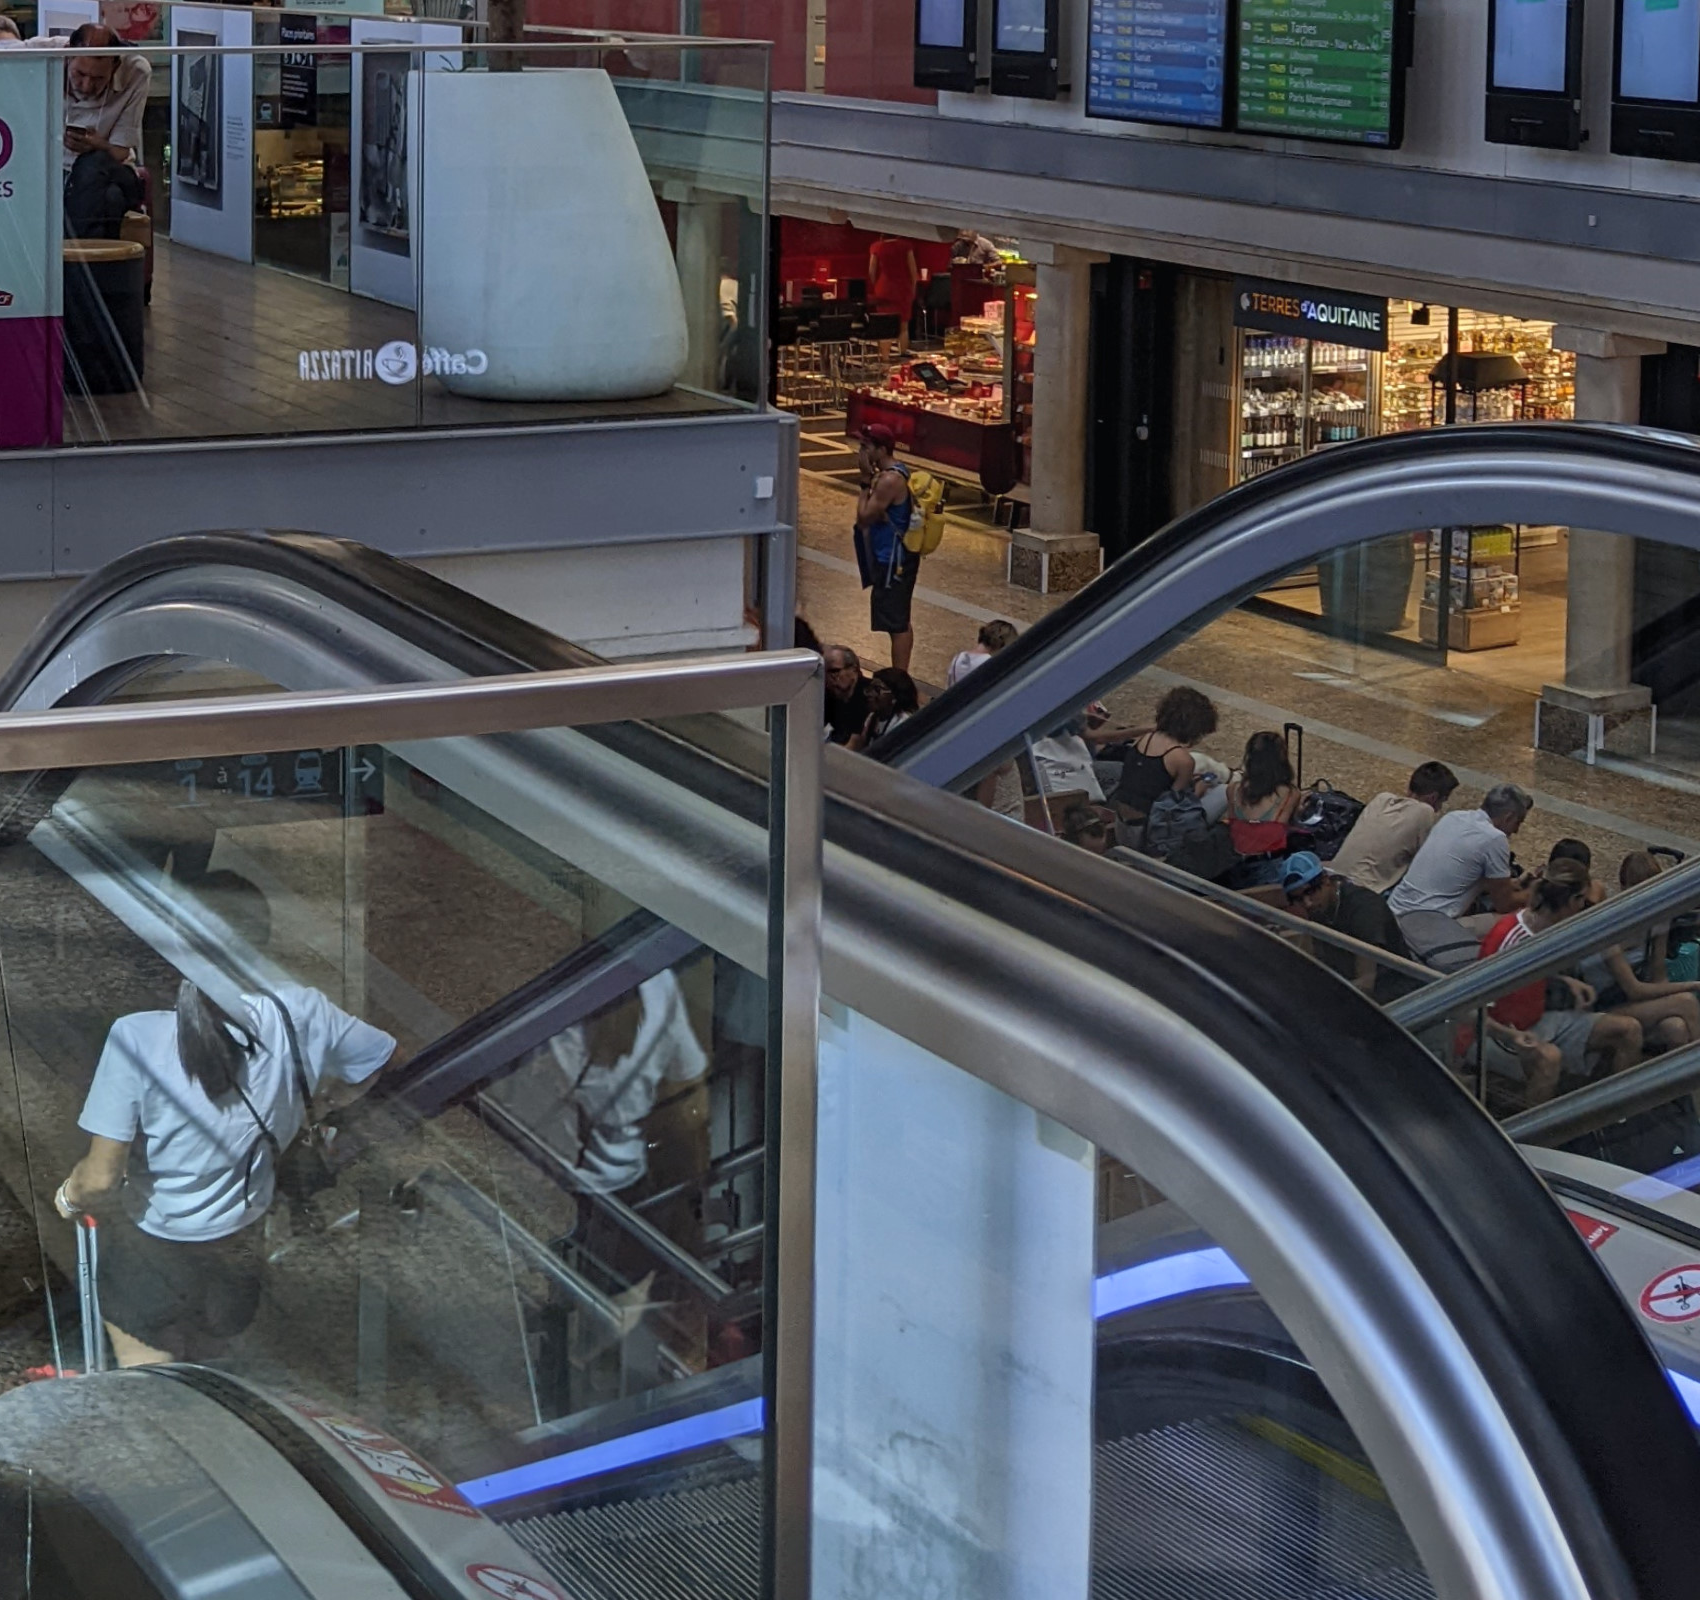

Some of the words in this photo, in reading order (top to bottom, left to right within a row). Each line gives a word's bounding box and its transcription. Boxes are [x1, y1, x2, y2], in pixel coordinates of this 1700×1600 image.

[1291, 21, 1317, 35] Tarbes
[1252, 292, 1300, 318] TERRES
[237, 766, 275, 798] 14
